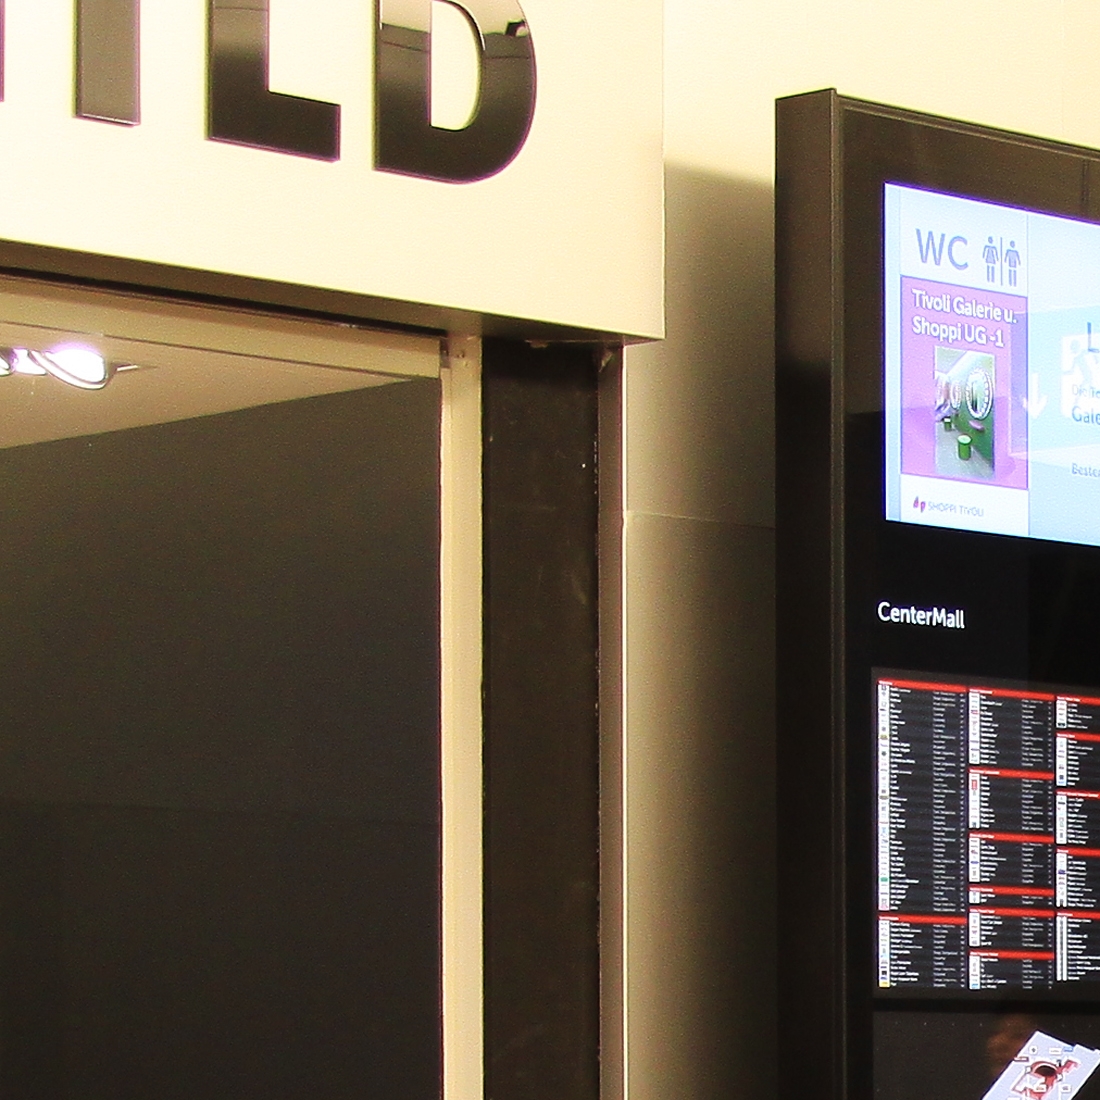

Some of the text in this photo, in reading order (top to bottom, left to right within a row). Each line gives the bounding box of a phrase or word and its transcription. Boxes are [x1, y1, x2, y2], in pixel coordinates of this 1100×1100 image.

[0, 0, 538, 185] ILD
[915, 228, 969, 271] WC
[911, 287, 1019, 325] Tivoli Galerie u.
[911, 315, 1006, 348] Shoppi UG -1
[876, 600, 966, 630] CenterMall
